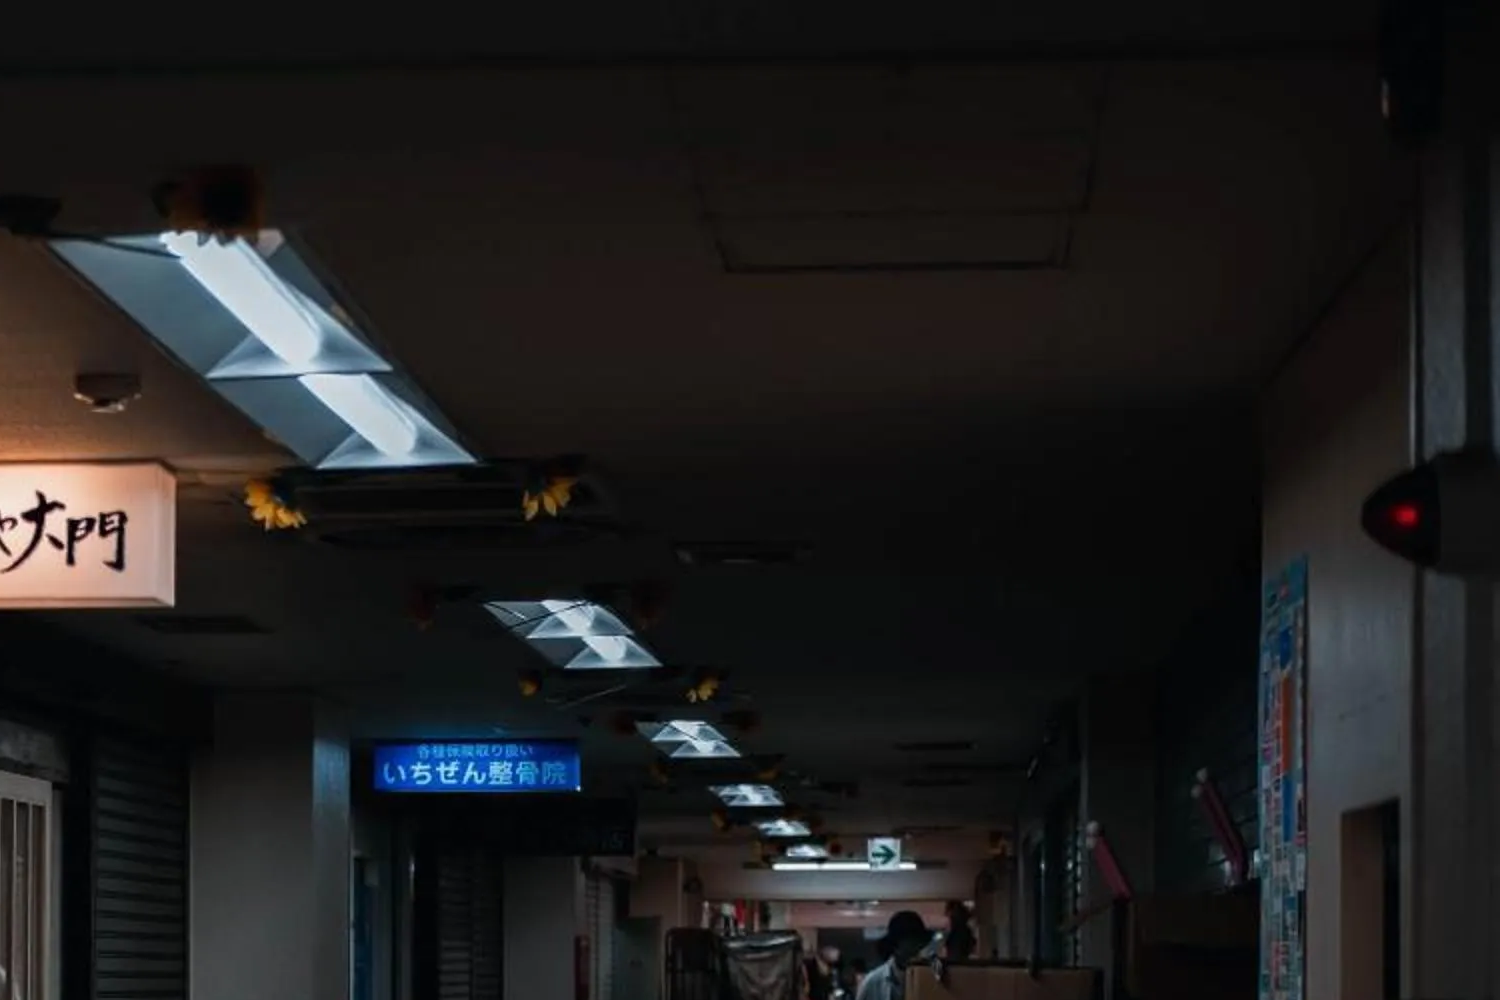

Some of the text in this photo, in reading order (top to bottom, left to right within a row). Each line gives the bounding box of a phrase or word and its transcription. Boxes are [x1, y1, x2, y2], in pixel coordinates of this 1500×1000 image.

[382, 759, 567, 786] いちぜん整骨院
